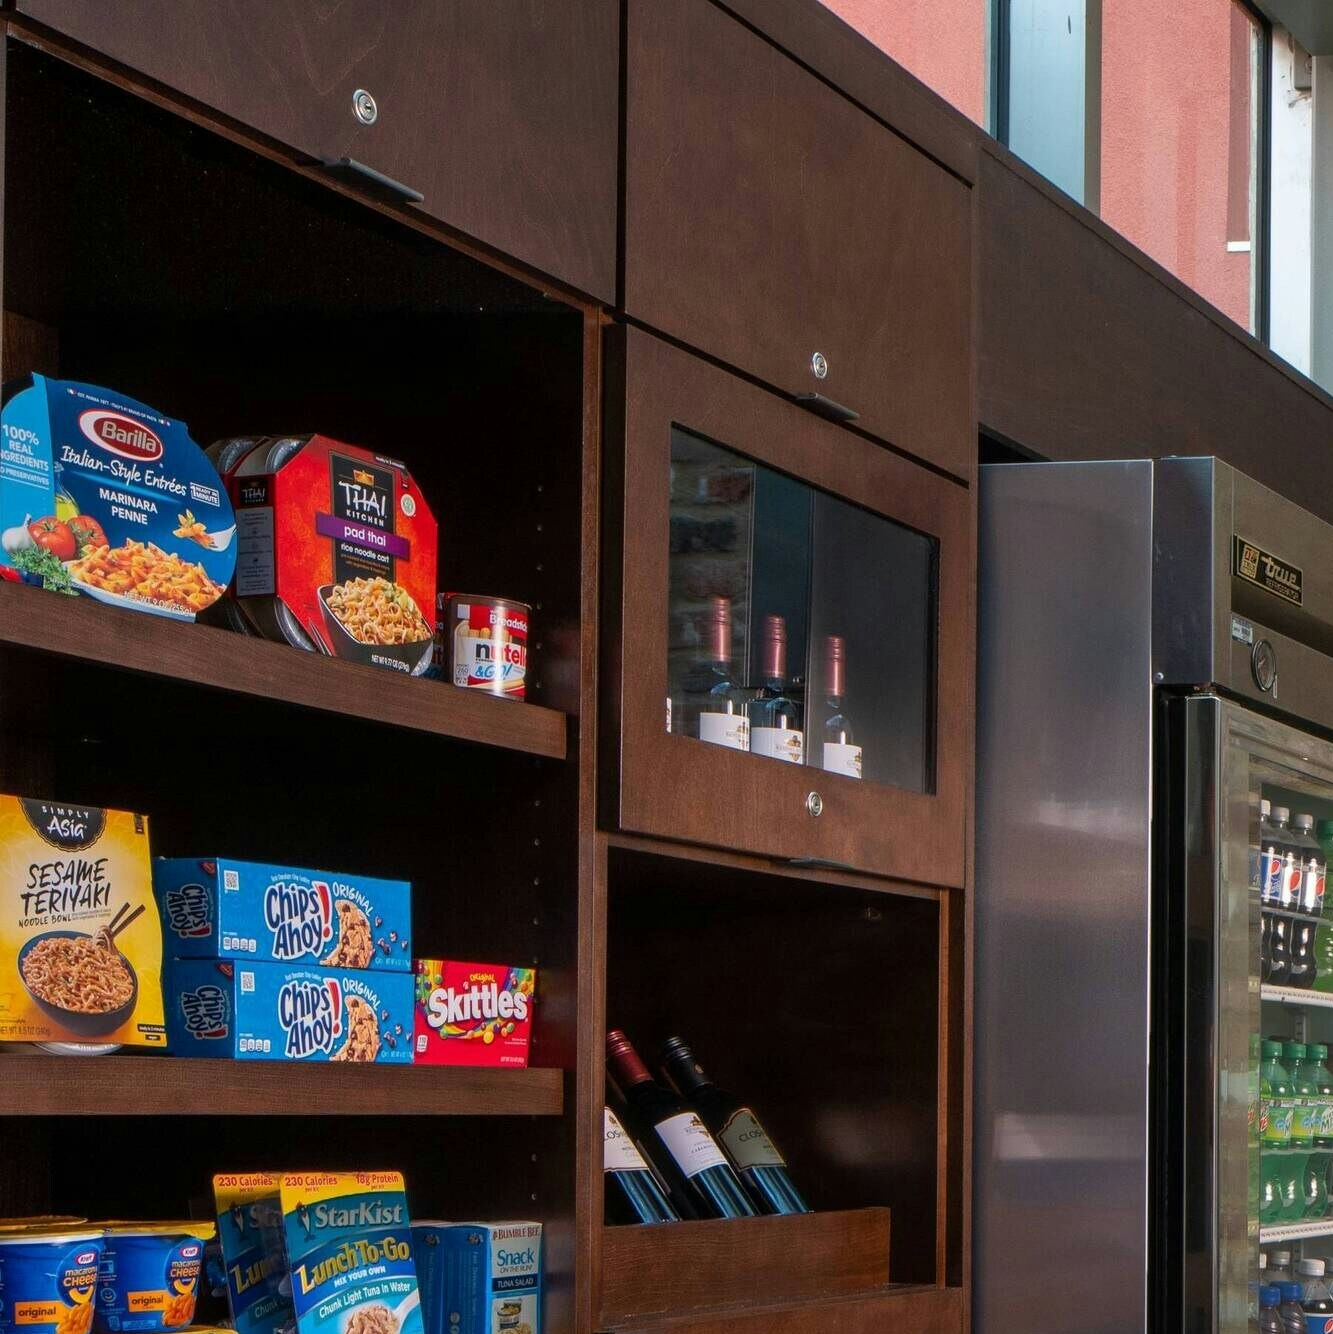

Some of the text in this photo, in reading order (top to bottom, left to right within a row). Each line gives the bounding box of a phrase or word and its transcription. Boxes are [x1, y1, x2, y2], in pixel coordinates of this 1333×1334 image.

[3, 424, 39, 446] 100%
[101, 421, 156, 453] Barilla
[9, 440, 34, 456] REAL
[0, 452, 49, 472] NGREDIENTS
[61, 446, 187, 497] Italian-Style Entrées
[100, 488, 158, 514] MARINARA
[338, 480, 386, 517] THAI
[111, 505, 149, 526] PENNE
[346, 509, 384, 527] KITCHEN
[344, 525, 387, 548] pad thai
[341, 543, 390, 564] rice noodle cart
[1261, 556, 1301, 592] true
[476, 643, 527, 667] nutell
[42, 805, 89, 820] SIMPLY
[47, 815, 86, 840] Asia
[26, 858, 109, 890] SESAME
[19, 882, 111, 917] TERIYAKI
[181, 884, 208, 931] Chips
[266, 884, 320, 928] Chips
[332, 881, 378, 917] ORIGINAL
[18, 914, 49, 929] NOODLE
[51, 913, 72, 925] BOWL
[280, 984, 330, 1028] Chips
[342, 977, 382, 1012] ORIGINAL
[427, 981, 528, 1028] Skittles
[196, 986, 222, 1030] Chips
[218, 1176, 273, 1186] 230 Calories
[285, 1175, 337, 1186] 230 Calories
[356, 1174, 399, 1186] 18g Protein
[315, 1200, 403, 1229] StarKist
[498, 1227, 539, 1239] BUMBLE BEE
[297, 1241, 356, 1295] Lunch
[497, 1248, 535, 1267] Snack
[349, 1270, 367, 1282] YOUR
[368, 1265, 386, 1275] OWN
[497, 1277, 533, 1288] TUNA SALAD
[131, 1296, 164, 1307] original
[319, 1282, 410, 1318] Chunk Light Tuna In Water
[18, 1307, 57, 1319] original
